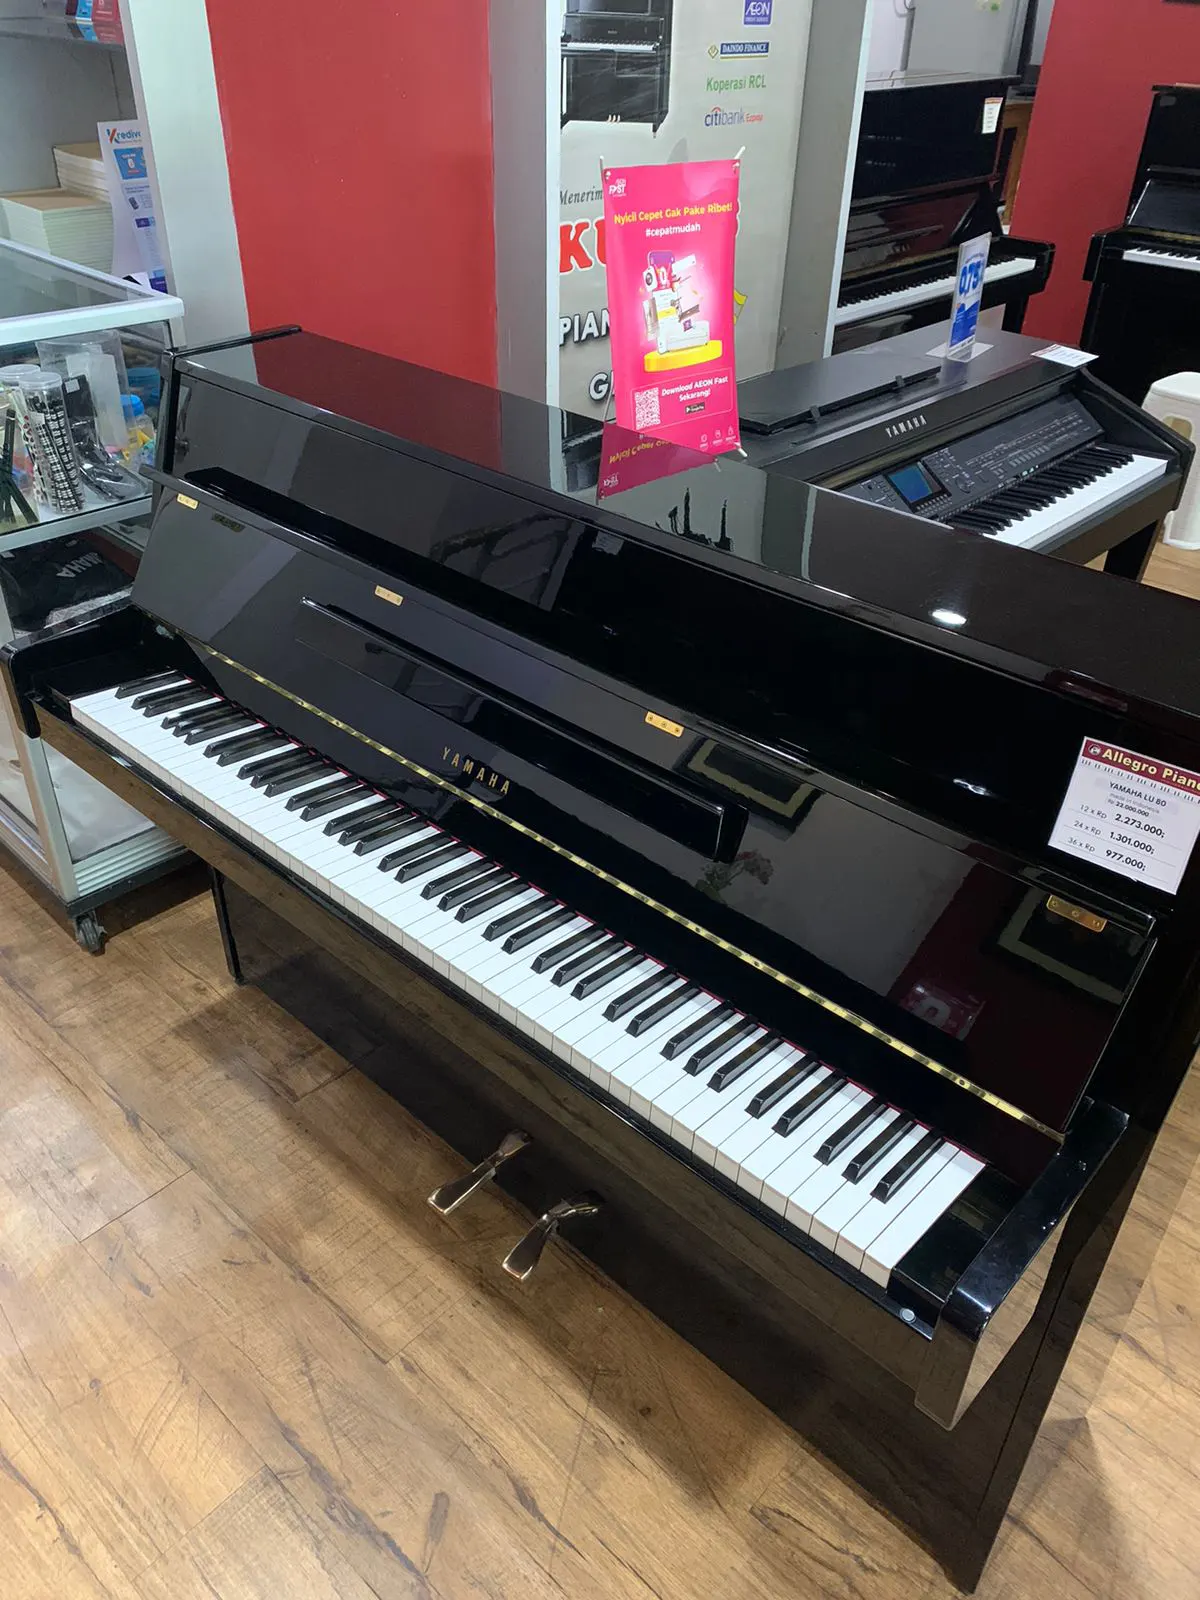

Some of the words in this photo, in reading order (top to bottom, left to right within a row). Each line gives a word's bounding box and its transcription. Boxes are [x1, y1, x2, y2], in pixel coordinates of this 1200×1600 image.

[744, 43, 767, 52] FINANCE
[706, 76, 747, 93] Koperasi
[748, 74, 767, 89] RCL
[704, 106, 745, 127] citibank
[614, 212, 637, 226] Nyicil
[638, 211, 663, 222] Cepet
[665, 207, 681, 217] Gak
[683, 205, 705, 215] Pake
[707, 202, 733, 213] Ribet!
[645, 223, 701, 238] #cepatmudah
[661, 382, 693, 397] Download
[693, 380, 713, 391] AEON
[713, 376, 729, 386] Fast
[679, 389, 712, 402] Sekarang!
[885, 414, 927, 438] YAMAHA
[442, 746, 510, 795] YAMAHA
[1102, 748, 1158, 775] Allegro
[1109, 781, 1143, 799] YAMAHA
[1143, 793, 1155, 803] LU
[1115, 800, 1150, 817] 22.000.000
[1080, 803, 1089, 812] 12
[1096, 810, 1107, 820] Rp
[1114, 813, 1166, 839] 2.273.000;
[1073, 820, 1083, 828] 24
[1090, 826, 1102, 836] Rp
[1109, 831, 1155, 855] 1.301.000;
[1067, 836, 1078, 846] 36
[1084, 843, 1096, 853] Rp
[1105, 848, 1147, 872] 977.000;
